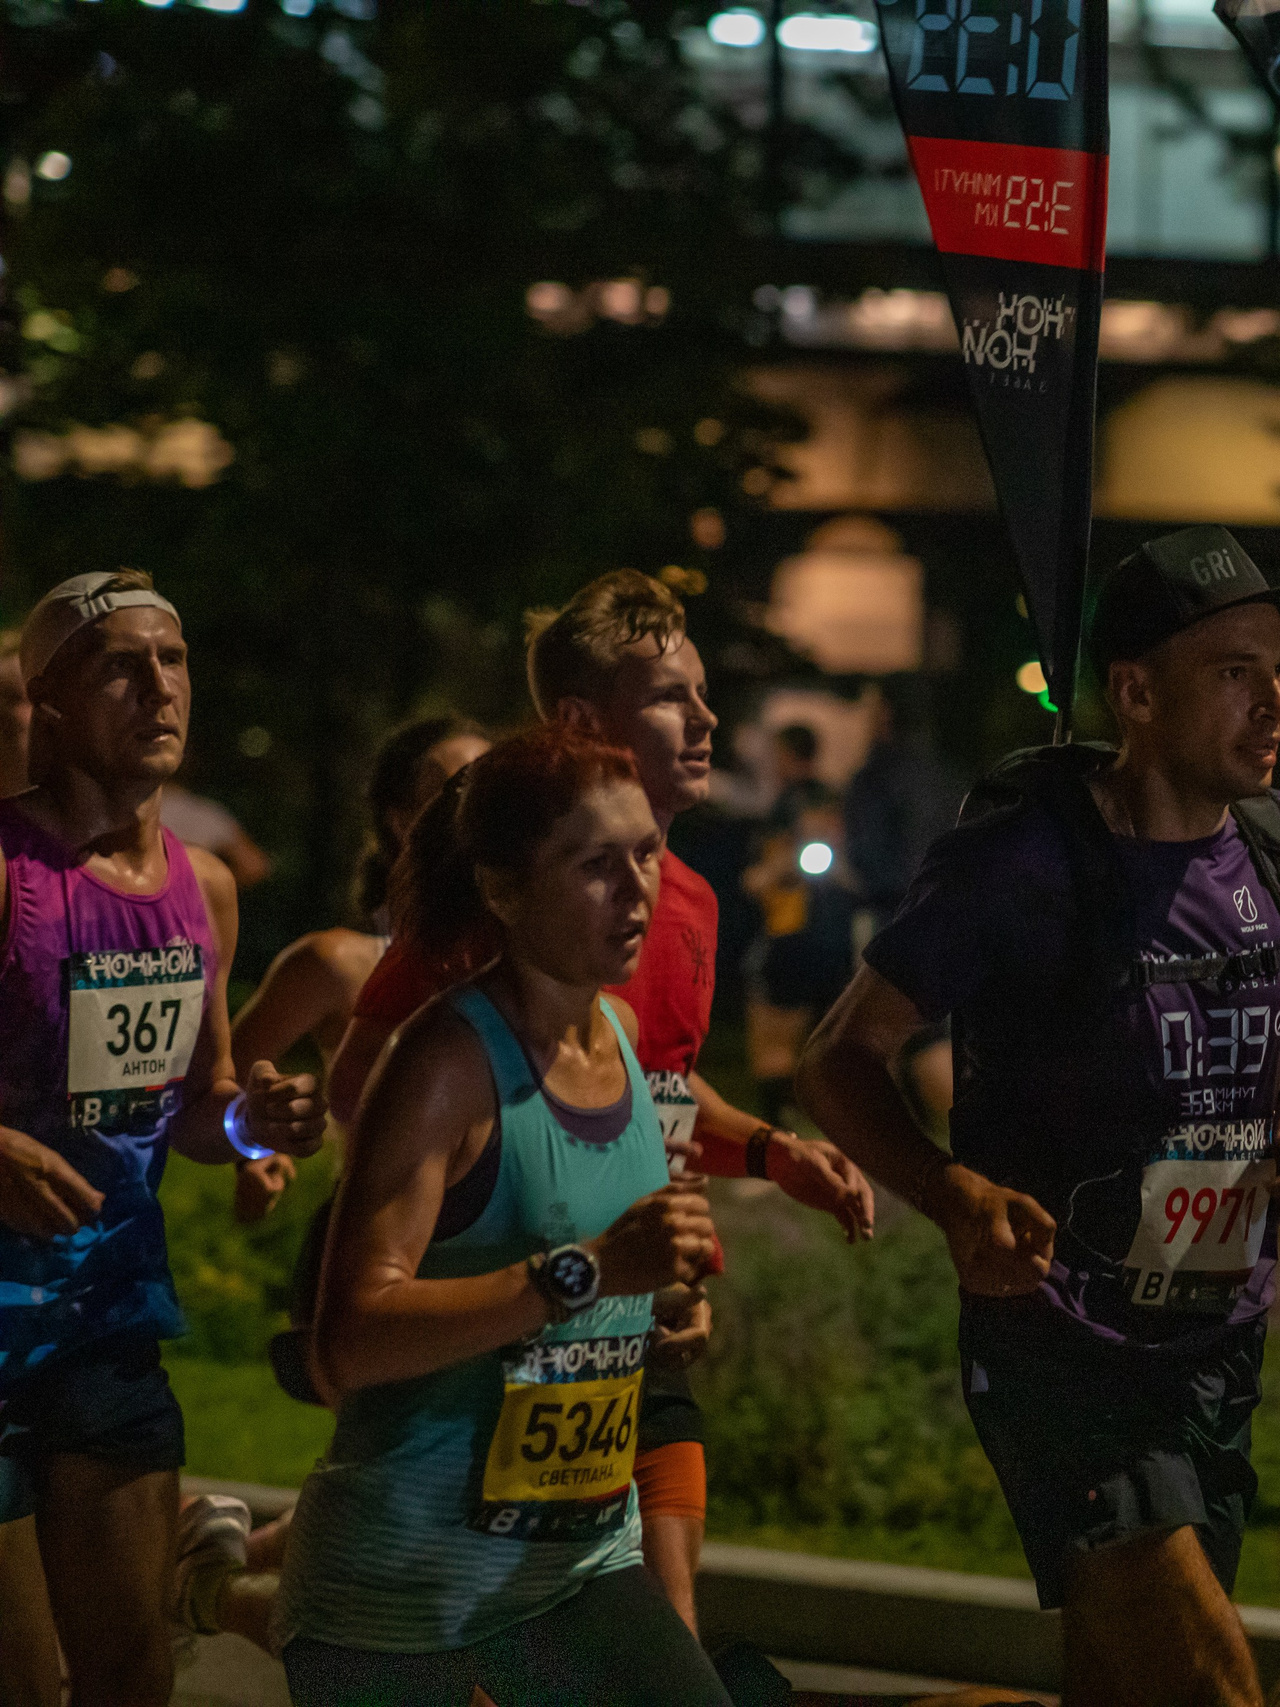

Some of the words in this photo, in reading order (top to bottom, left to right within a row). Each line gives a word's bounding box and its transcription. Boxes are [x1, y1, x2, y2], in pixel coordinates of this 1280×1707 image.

[1190, 548, 1236, 587] GRi
[107, 1000, 182, 1057] 367
[1161, 1006, 1271, 1080] 0:39
[122, 1059, 166, 1077] АНТОН
[1164, 1187, 1257, 1244] 9971
[521, 1392, 635, 1462] 5346
[538, 1463, 614, 1488] СВЕТЛАНА
